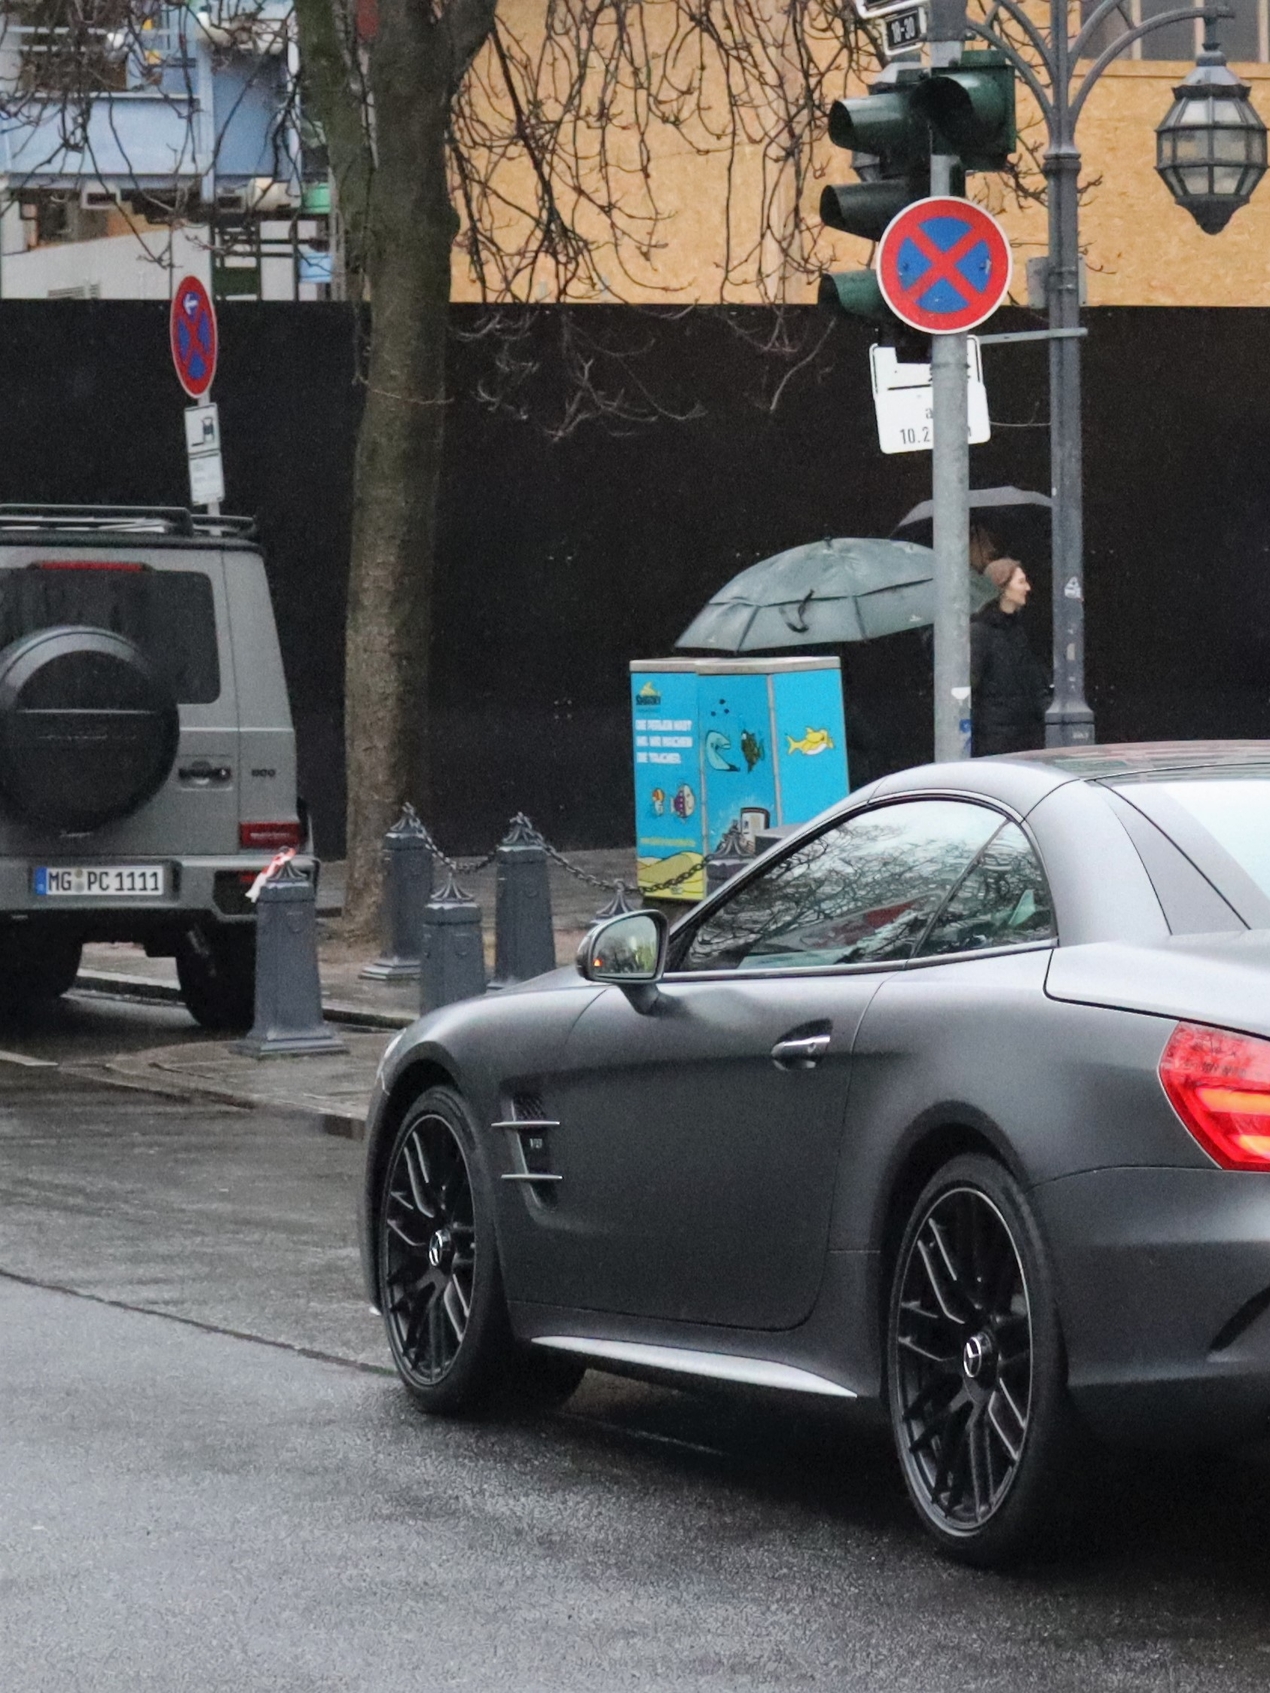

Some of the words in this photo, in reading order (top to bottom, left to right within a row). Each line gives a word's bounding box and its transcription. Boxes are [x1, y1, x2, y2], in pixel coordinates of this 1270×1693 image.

[900, 426, 934, 445] 10.2
[48, 871, 72, 892] MG
[86, 871, 110, 892] PC
[114, 871, 160, 892] 1111
